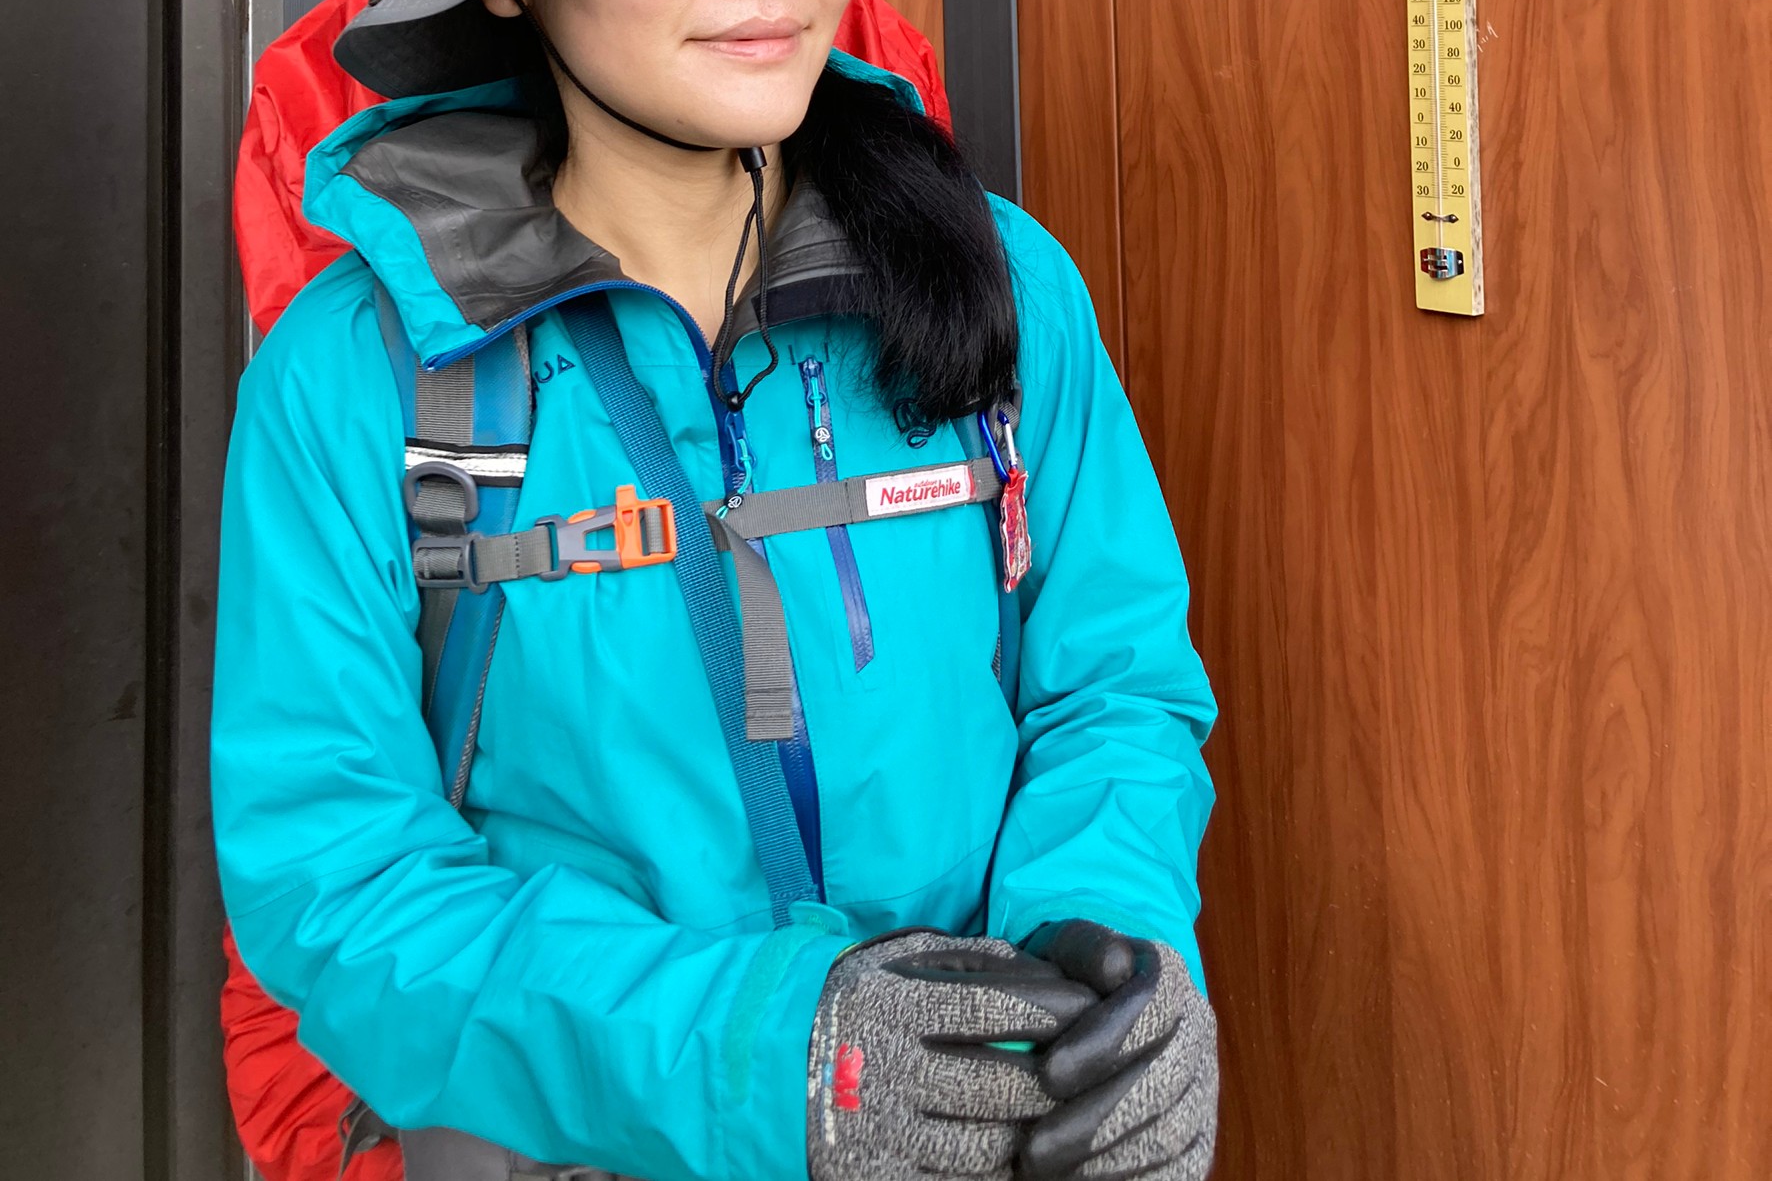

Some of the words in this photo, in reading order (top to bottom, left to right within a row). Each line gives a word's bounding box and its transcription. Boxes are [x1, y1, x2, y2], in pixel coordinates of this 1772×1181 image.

[1412, 15, 1424, 25] 40
[1445, 20, 1462, 30] 100
[1413, 39, 1425, 49] 30
[1447, 47, 1460, 57] 80
[1413, 63, 1426, 73] 20
[1448, 75, 1460, 84] 60
[1415, 88, 1426, 97] 10
[1449, 102, 1461, 112] 40
[1418, 112, 1424, 122] 0
[1449, 130, 1462, 140] 20
[1416, 136, 1427, 146] 10
[1416, 161, 1428, 171] 20
[1454, 157, 1460, 167] 0
[1416, 185, 1429, 195] 30
[1451, 184, 1464, 195] 20
[880, 478, 961, 506] Naturehike
